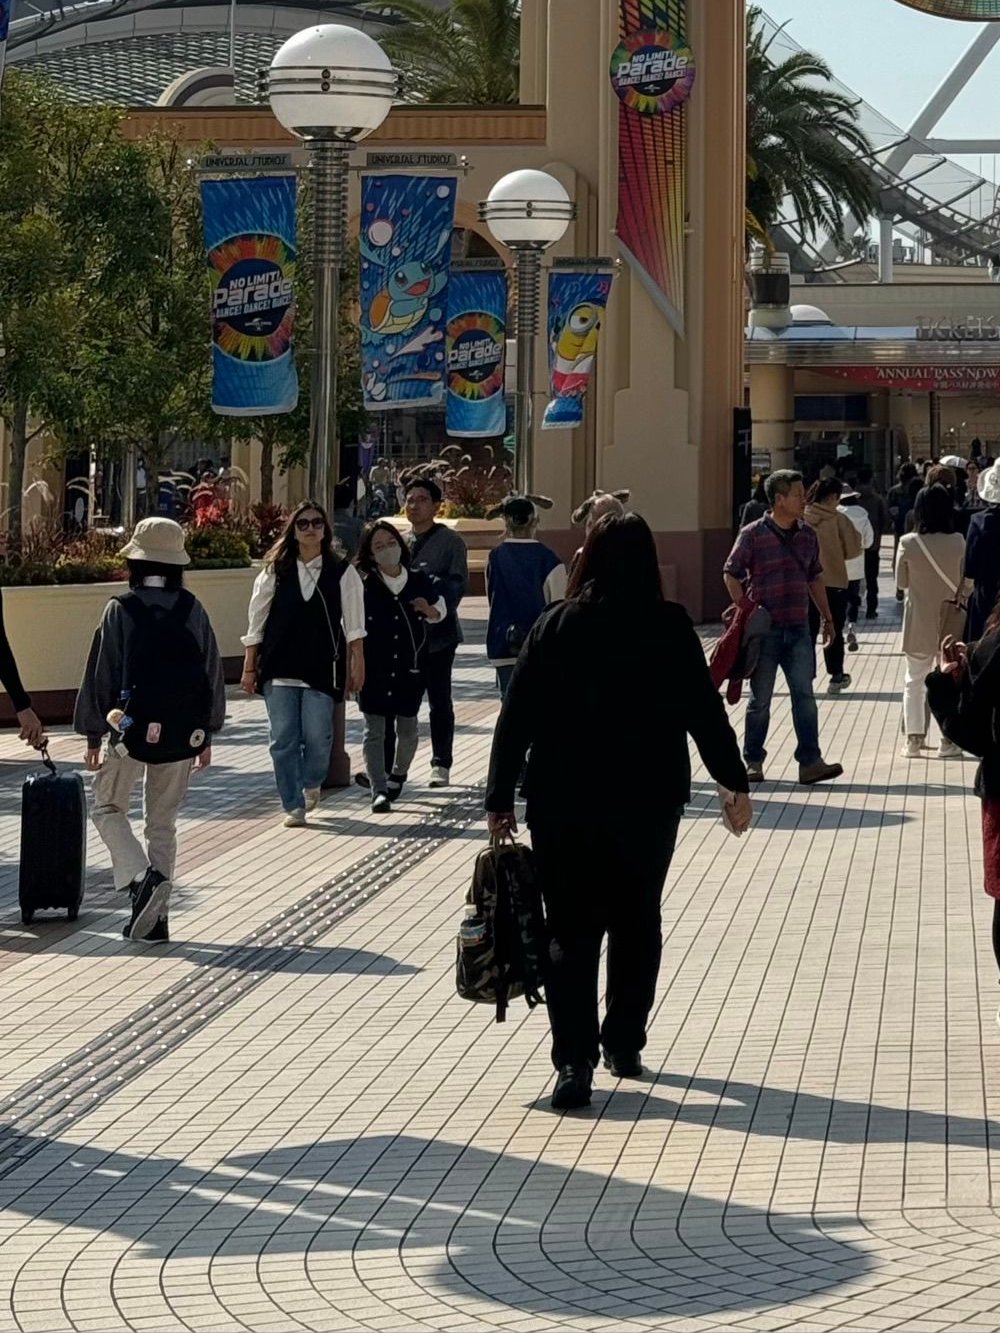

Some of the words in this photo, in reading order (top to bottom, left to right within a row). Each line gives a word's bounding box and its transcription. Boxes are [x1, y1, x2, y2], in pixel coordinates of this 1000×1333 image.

[632, 54, 645, 63] NO
[646, 50, 673, 61] LIMIT!
[206, 157, 249, 166] UNIVERSAL
[252, 156, 287, 165] STUDIOS
[372, 155, 414, 164] UNIVERSAL
[416, 155, 451, 164] STUDIOS
[229, 278, 245, 290] NO
[247, 271, 280, 286] LIMIT!
[243, 299, 271, 314] DANCE!
[917, 316, 998, 339] TICKETS
[876, 368, 931, 379] ANNUAL
[934, 368, 964, 379] PASS
[966, 368, 999, 379] NOW
